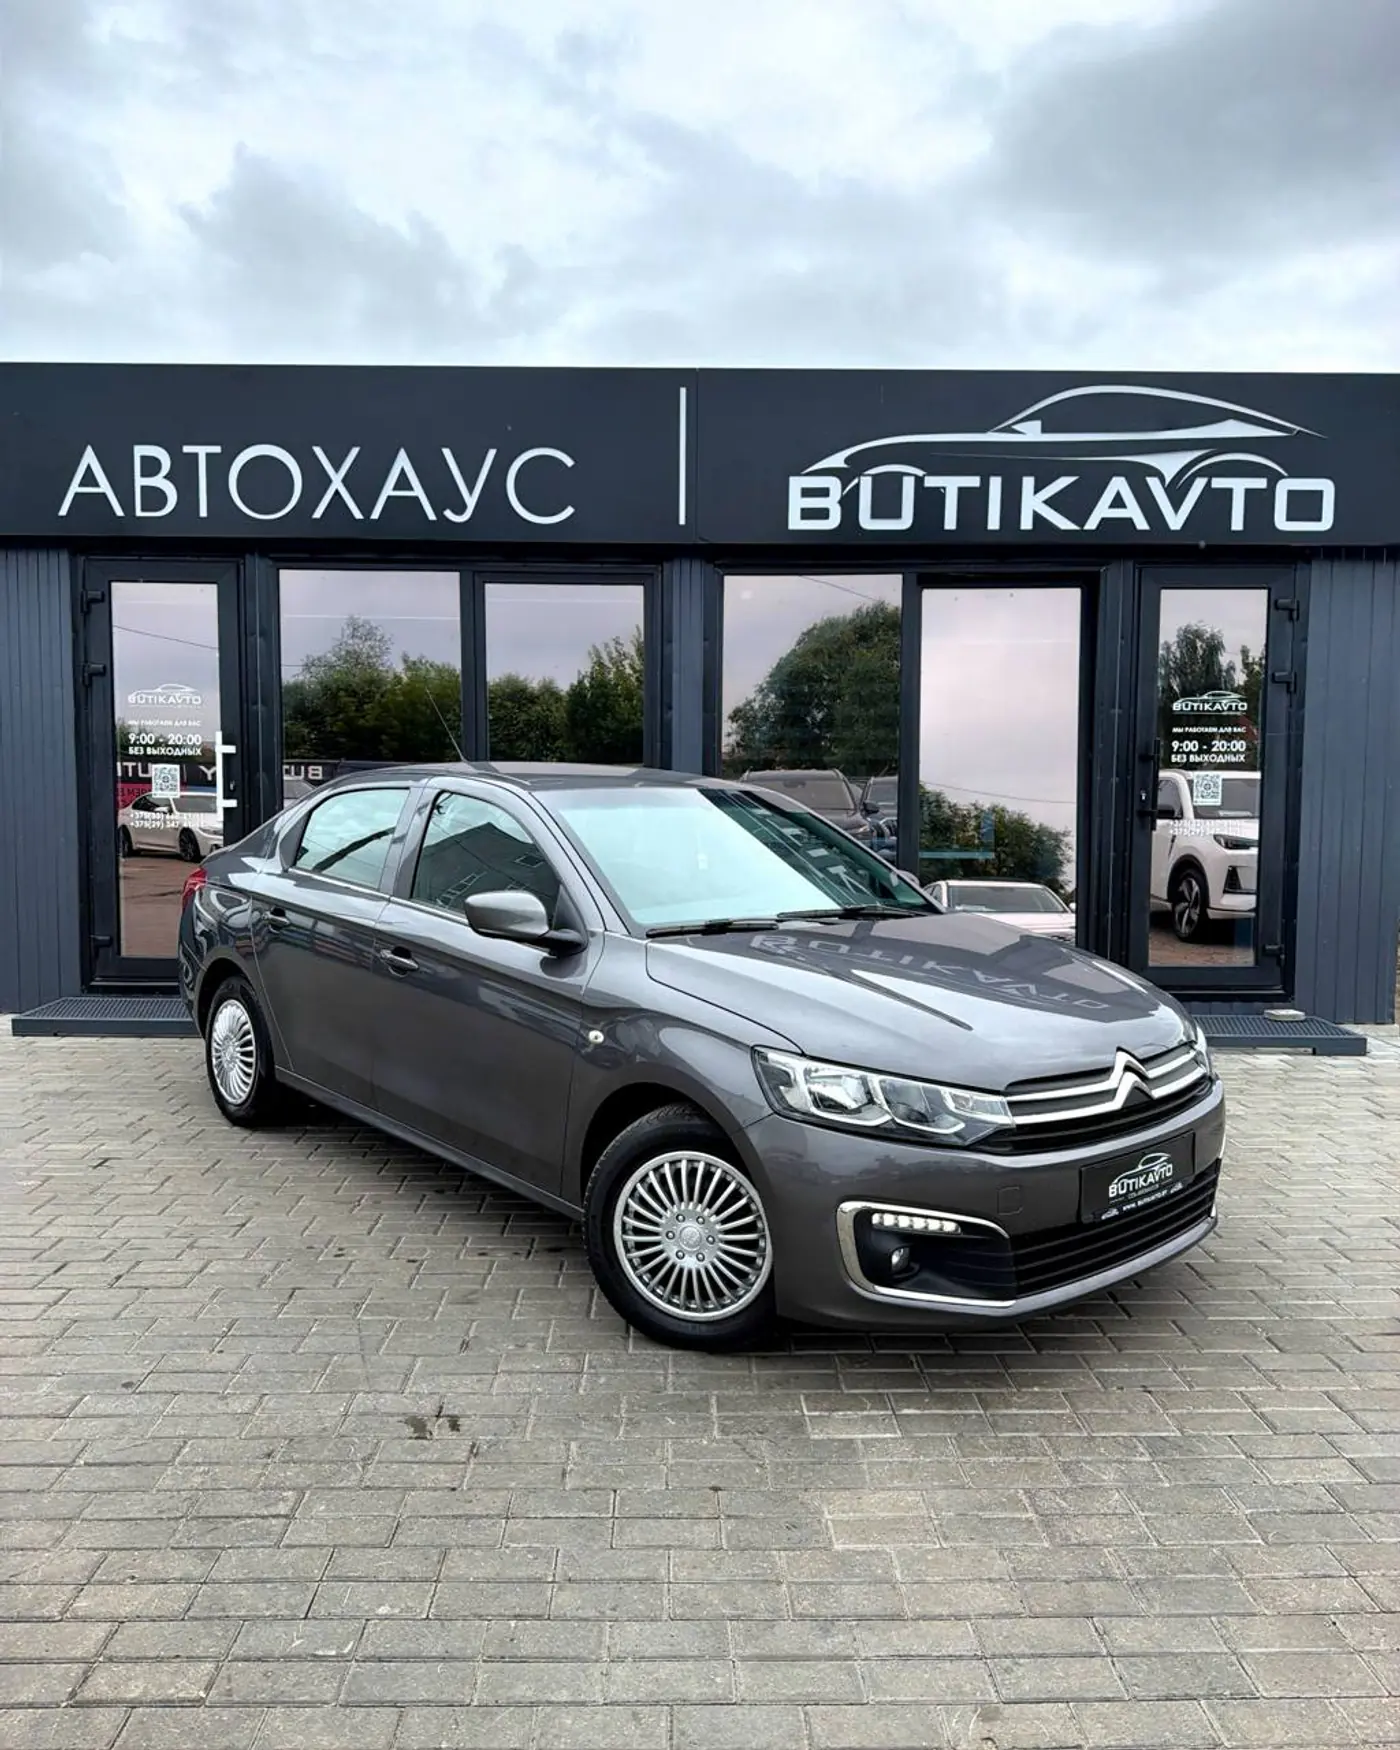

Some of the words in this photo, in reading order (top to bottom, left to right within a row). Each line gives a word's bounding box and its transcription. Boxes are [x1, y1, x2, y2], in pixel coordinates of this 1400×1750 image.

[58, 444, 576, 524] АВТОХАУС
[788, 474, 1336, 532] BUTIKAVTO
[1172, 702, 1248, 711] BUTIKAVTO
[128, 733, 155, 744] 9:00
[168, 733, 202, 745] 20:00
[128, 746, 144, 755] БЕЗ
[146, 746, 202, 756] ВЫХОДНЫХ
[1171, 740, 1199, 752] 9:00
[1211, 740, 1247, 752] 20:00
[1171, 754, 1187, 763] БЕЗ
[1189, 754, 1246, 763] ВЫХОДНЫХ
[1108, 1163, 1173, 1198] BUTIKAVTO
